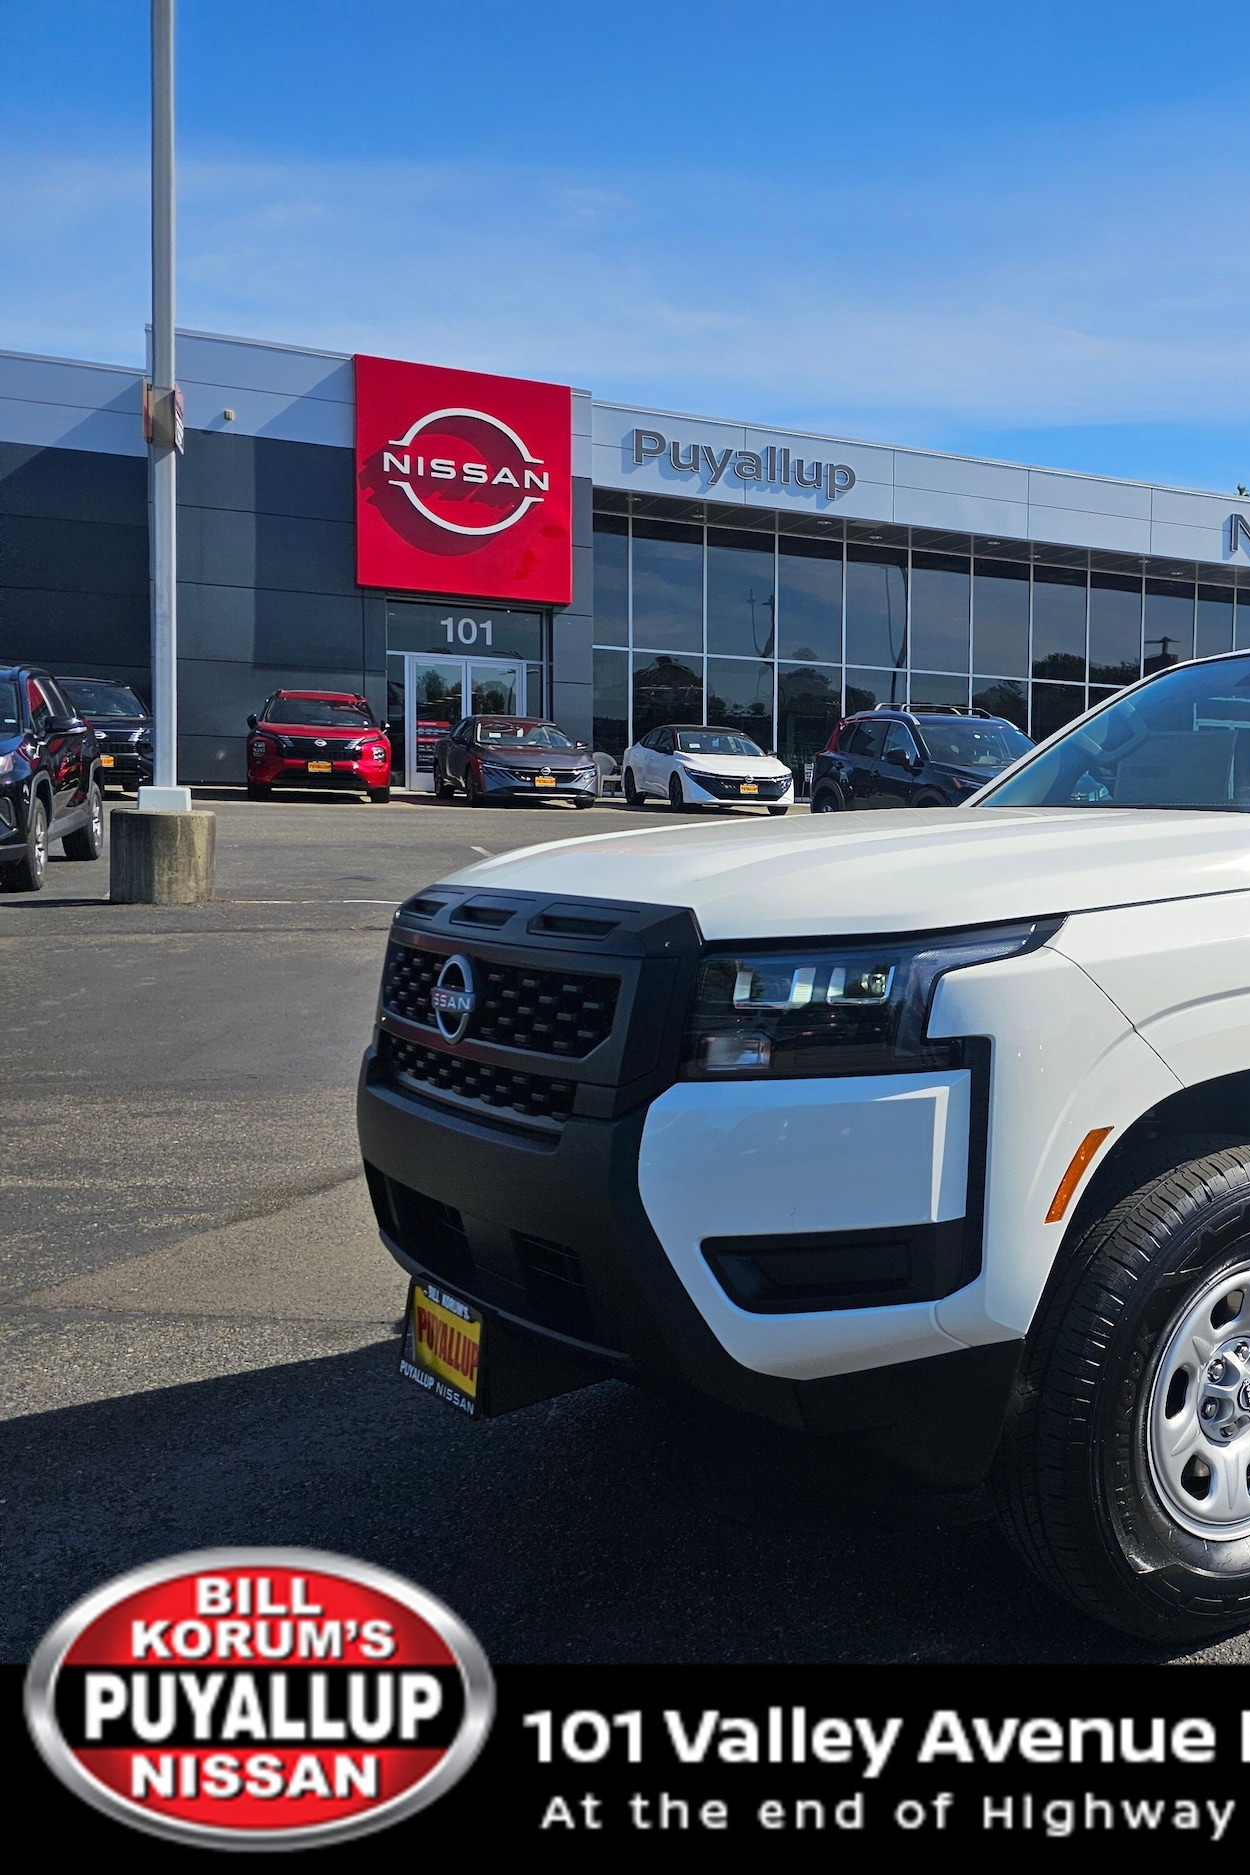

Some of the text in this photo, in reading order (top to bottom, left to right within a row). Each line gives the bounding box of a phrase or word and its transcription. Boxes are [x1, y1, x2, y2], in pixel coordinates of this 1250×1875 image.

[383, 451, 549, 491] NISSAN
[634, 428, 856, 500] Puyallup
[440, 616, 492, 645] 101
[417, 1306, 480, 1382] PUYALLUP
[400, 1360, 475, 1416] PUYALLUP NISSAN
